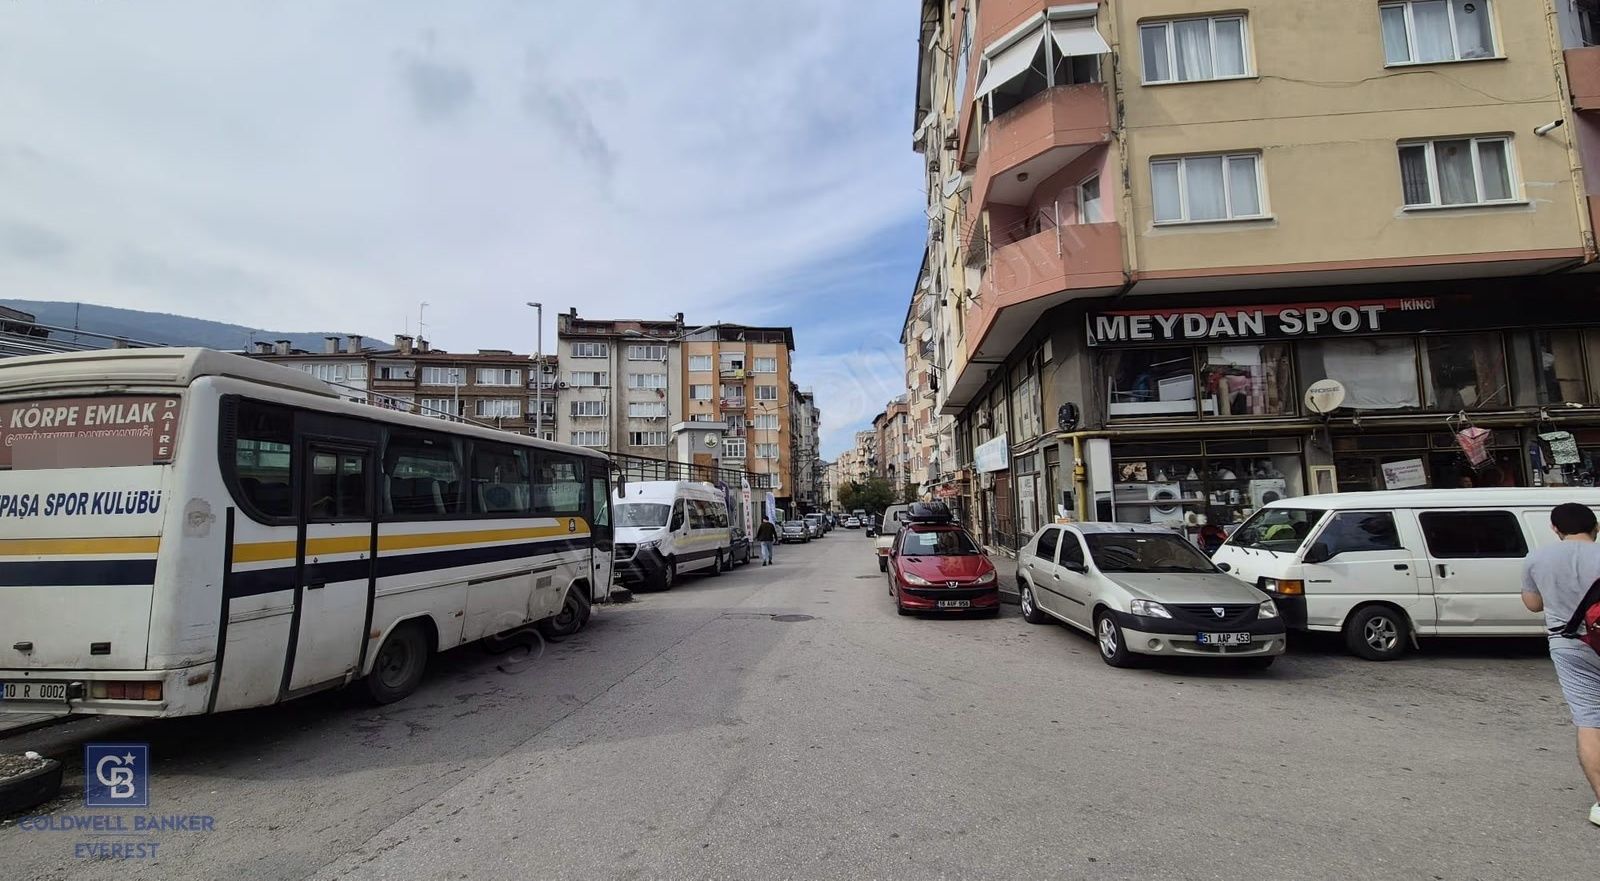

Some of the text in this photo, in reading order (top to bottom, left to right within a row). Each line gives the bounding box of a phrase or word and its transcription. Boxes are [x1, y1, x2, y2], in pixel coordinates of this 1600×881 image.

[1095, 304, 1386, 341] MEYDAN SPOT
[10, 403, 79, 428] KÖRPE
[84, 402, 157, 426] EMLAK
[0, 490, 162, 519] PAŞA SPOR KULÜBÜ
[1203, 633, 1250, 643] 51 AAP 453
[5, 684, 65, 699] 10 R 0002
